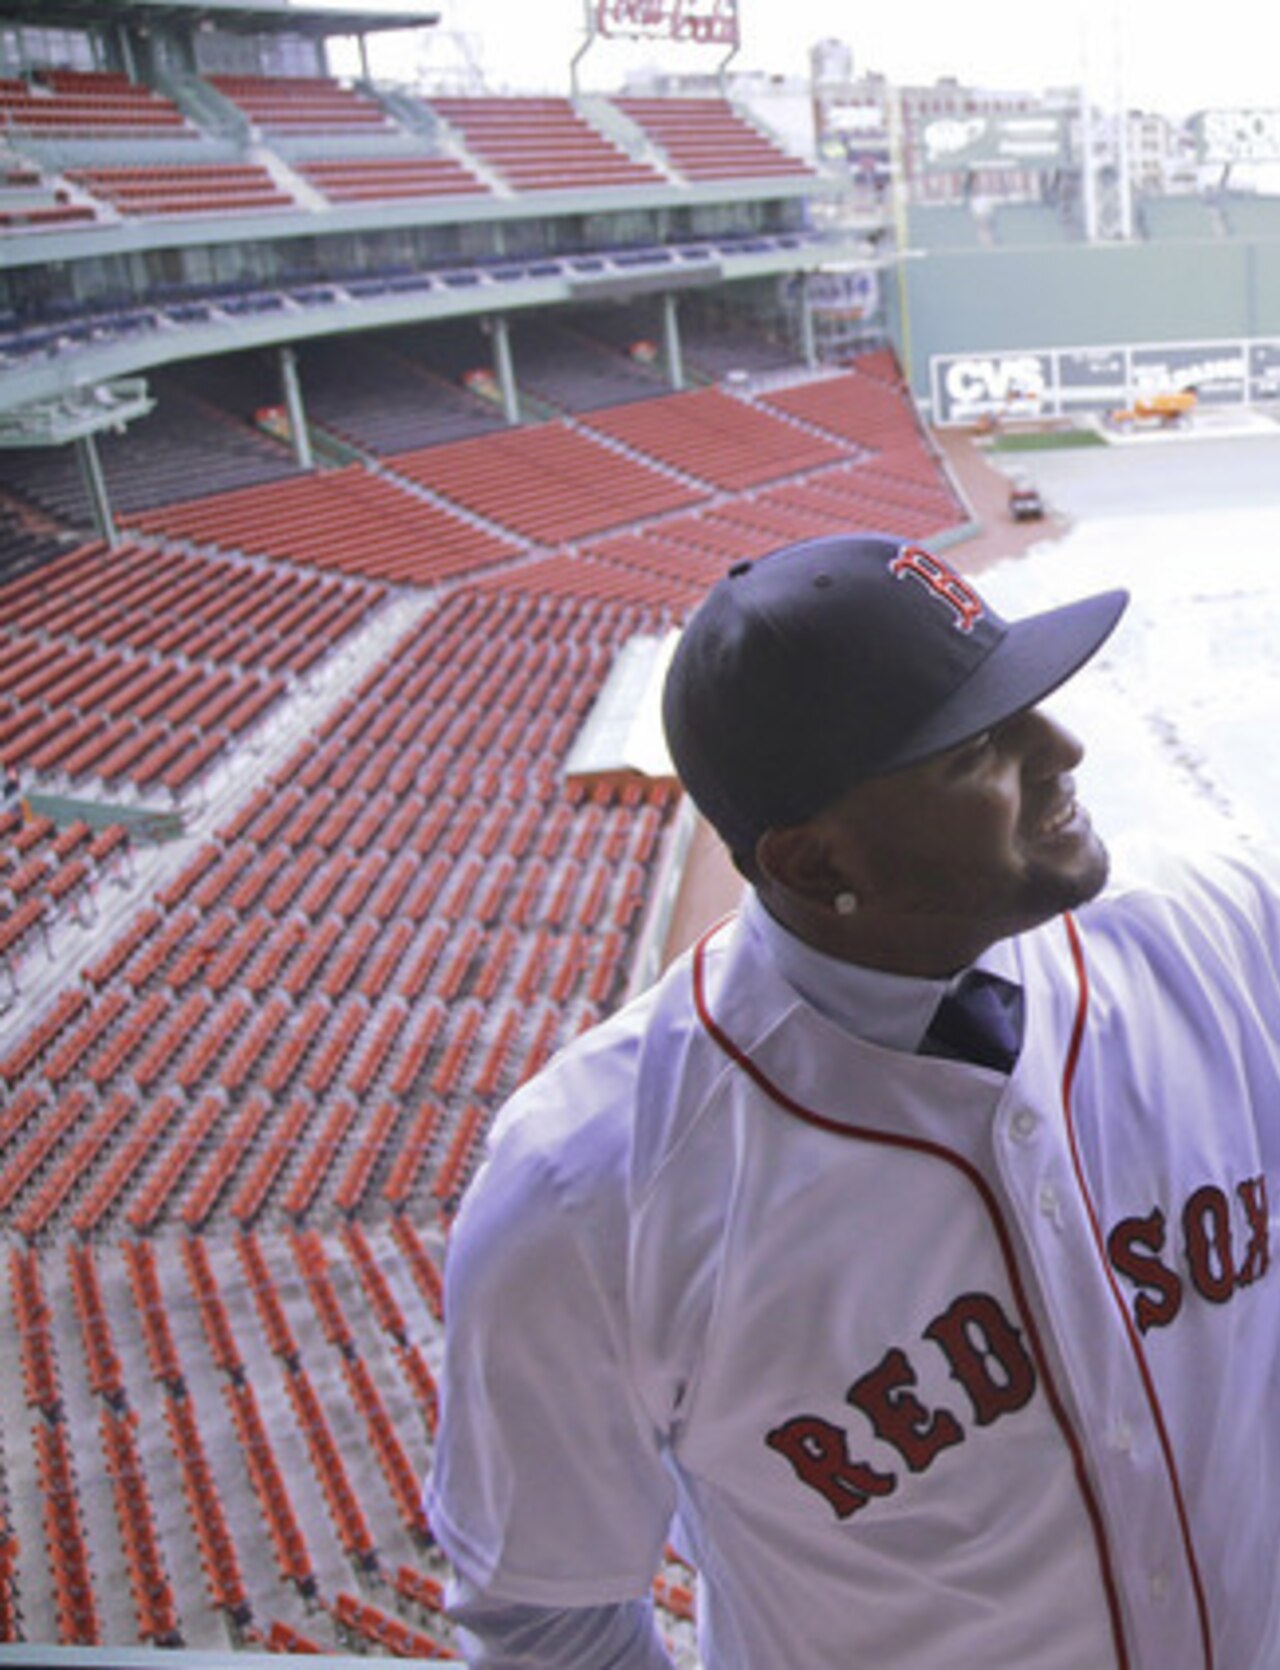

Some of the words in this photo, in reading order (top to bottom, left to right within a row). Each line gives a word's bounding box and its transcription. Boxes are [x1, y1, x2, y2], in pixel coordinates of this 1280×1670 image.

[948, 356, 1043, 401] CVS
[889, 545, 984, 635] B
[764, 1291, 1037, 1520] RED
[1107, 1174, 1271, 1336] SOX
